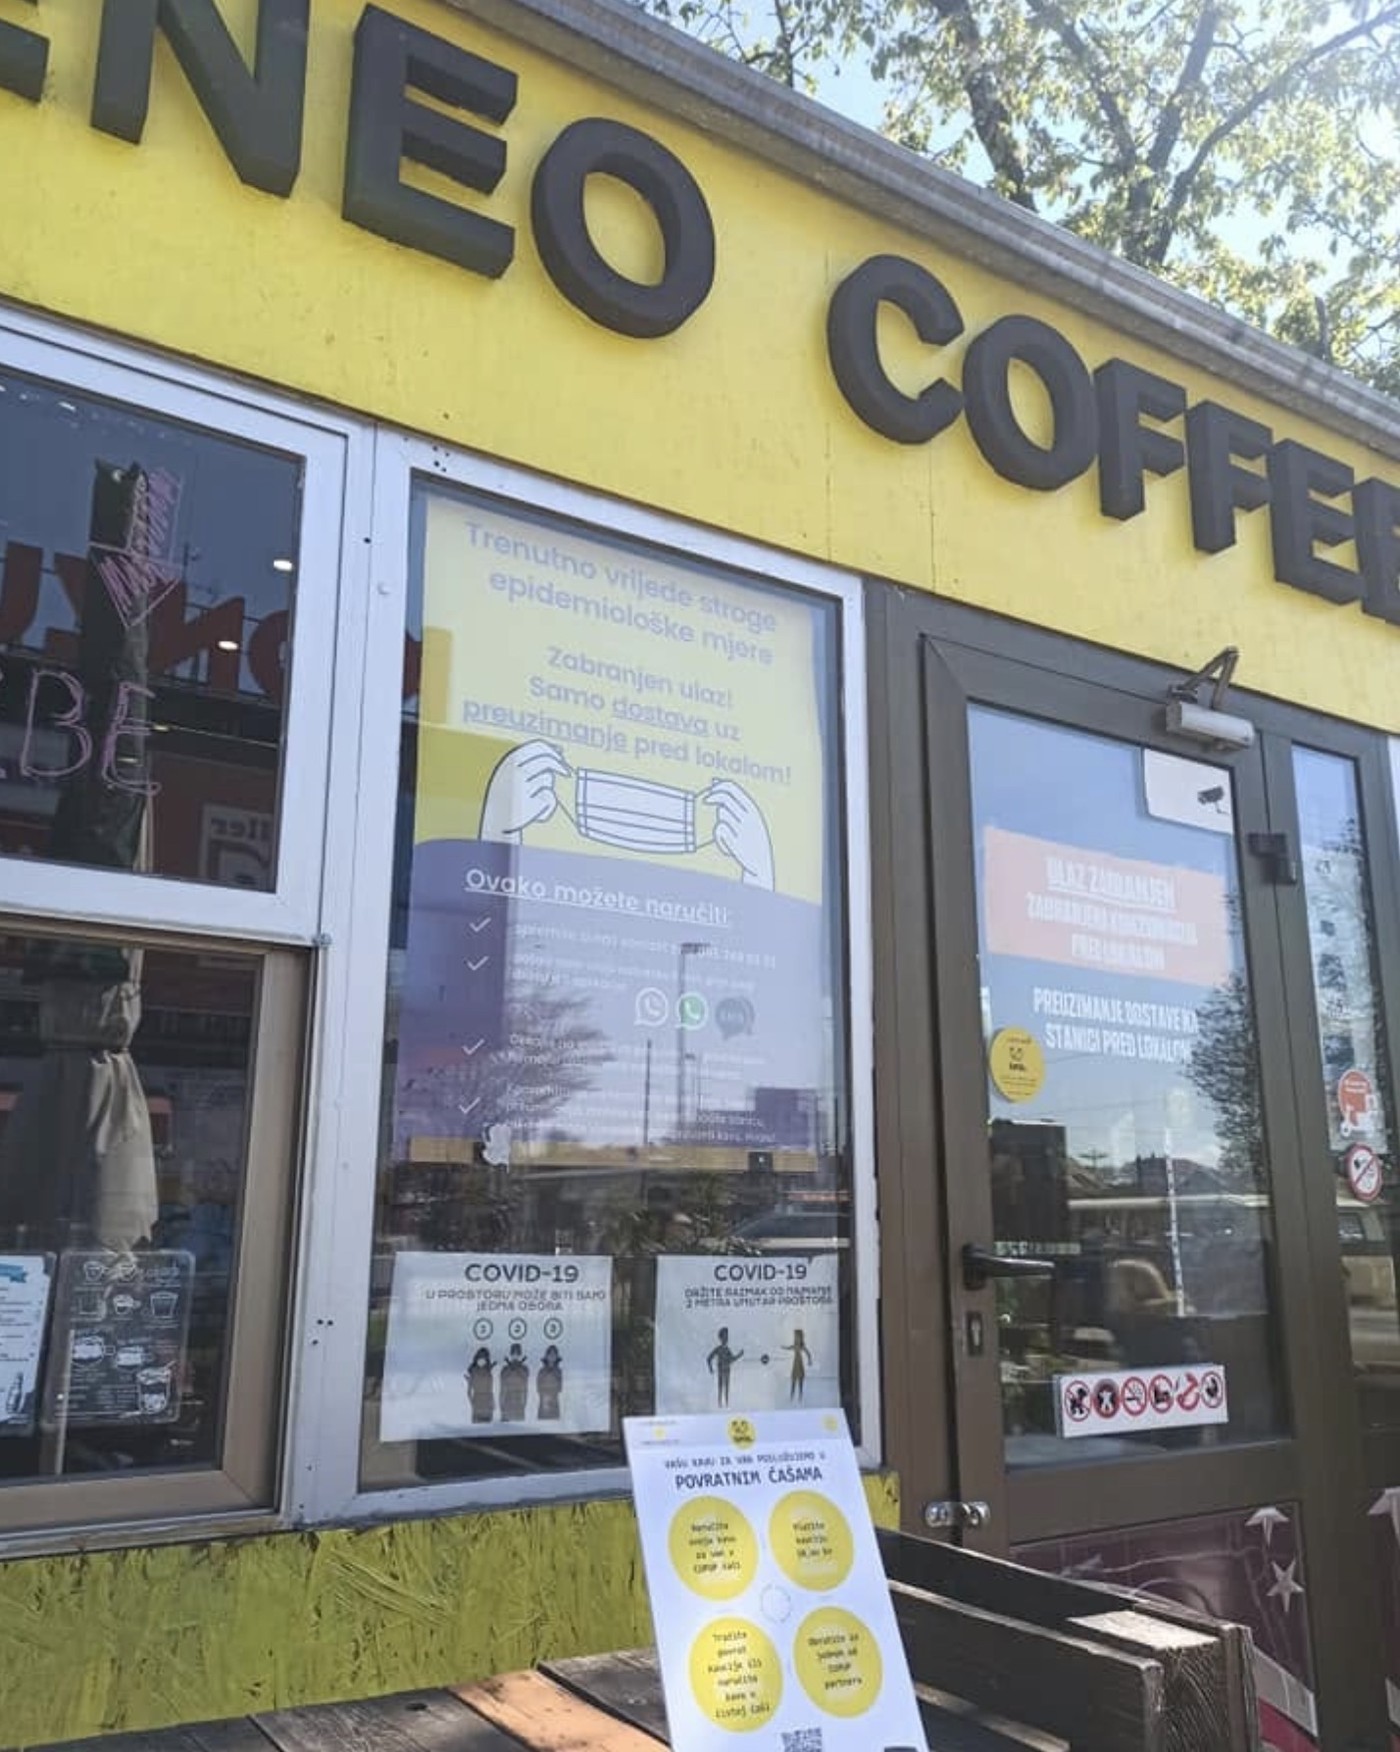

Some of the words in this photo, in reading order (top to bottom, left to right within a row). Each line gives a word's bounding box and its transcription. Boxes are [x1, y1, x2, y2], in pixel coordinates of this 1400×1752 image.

[0, 0, 716, 339] NEO
[466, 521, 597, 579] Trenutno
[605, 566, 693, 608] vrijede
[699, 595, 777, 634] stroge
[489, 569, 695, 643] epidemiološke
[703, 628, 773, 664] mjere
[547, 645, 674, 699] Zabranjen
[680, 676, 733, 708] ulaz!
[529, 675, 605, 712] Samo
[612, 695, 709, 736] dostava
[715, 720, 741, 742] uz
[462, 697, 630, 753] preuzimanje
[634, 731, 689, 763] pred
[695, 744, 791, 785] lokalom!
[464, 867, 546, 902] Ovako
[554, 880, 640, 911] možete
[1032, 987, 1124, 1025] PREUZIMANJE
[1125, 1002, 1181, 1031] DOSTAVE
[1044, 1021, 1101, 1053] STANICI
[1102, 1028, 1137, 1058] PRED
[465, 1263, 580, 1284] COVID-19
[713, 1263, 808, 1282] COVID-19
[675, 1469, 762, 1490] POVRATNIM
[768, 1464, 824, 1484] ČAŠAMA
